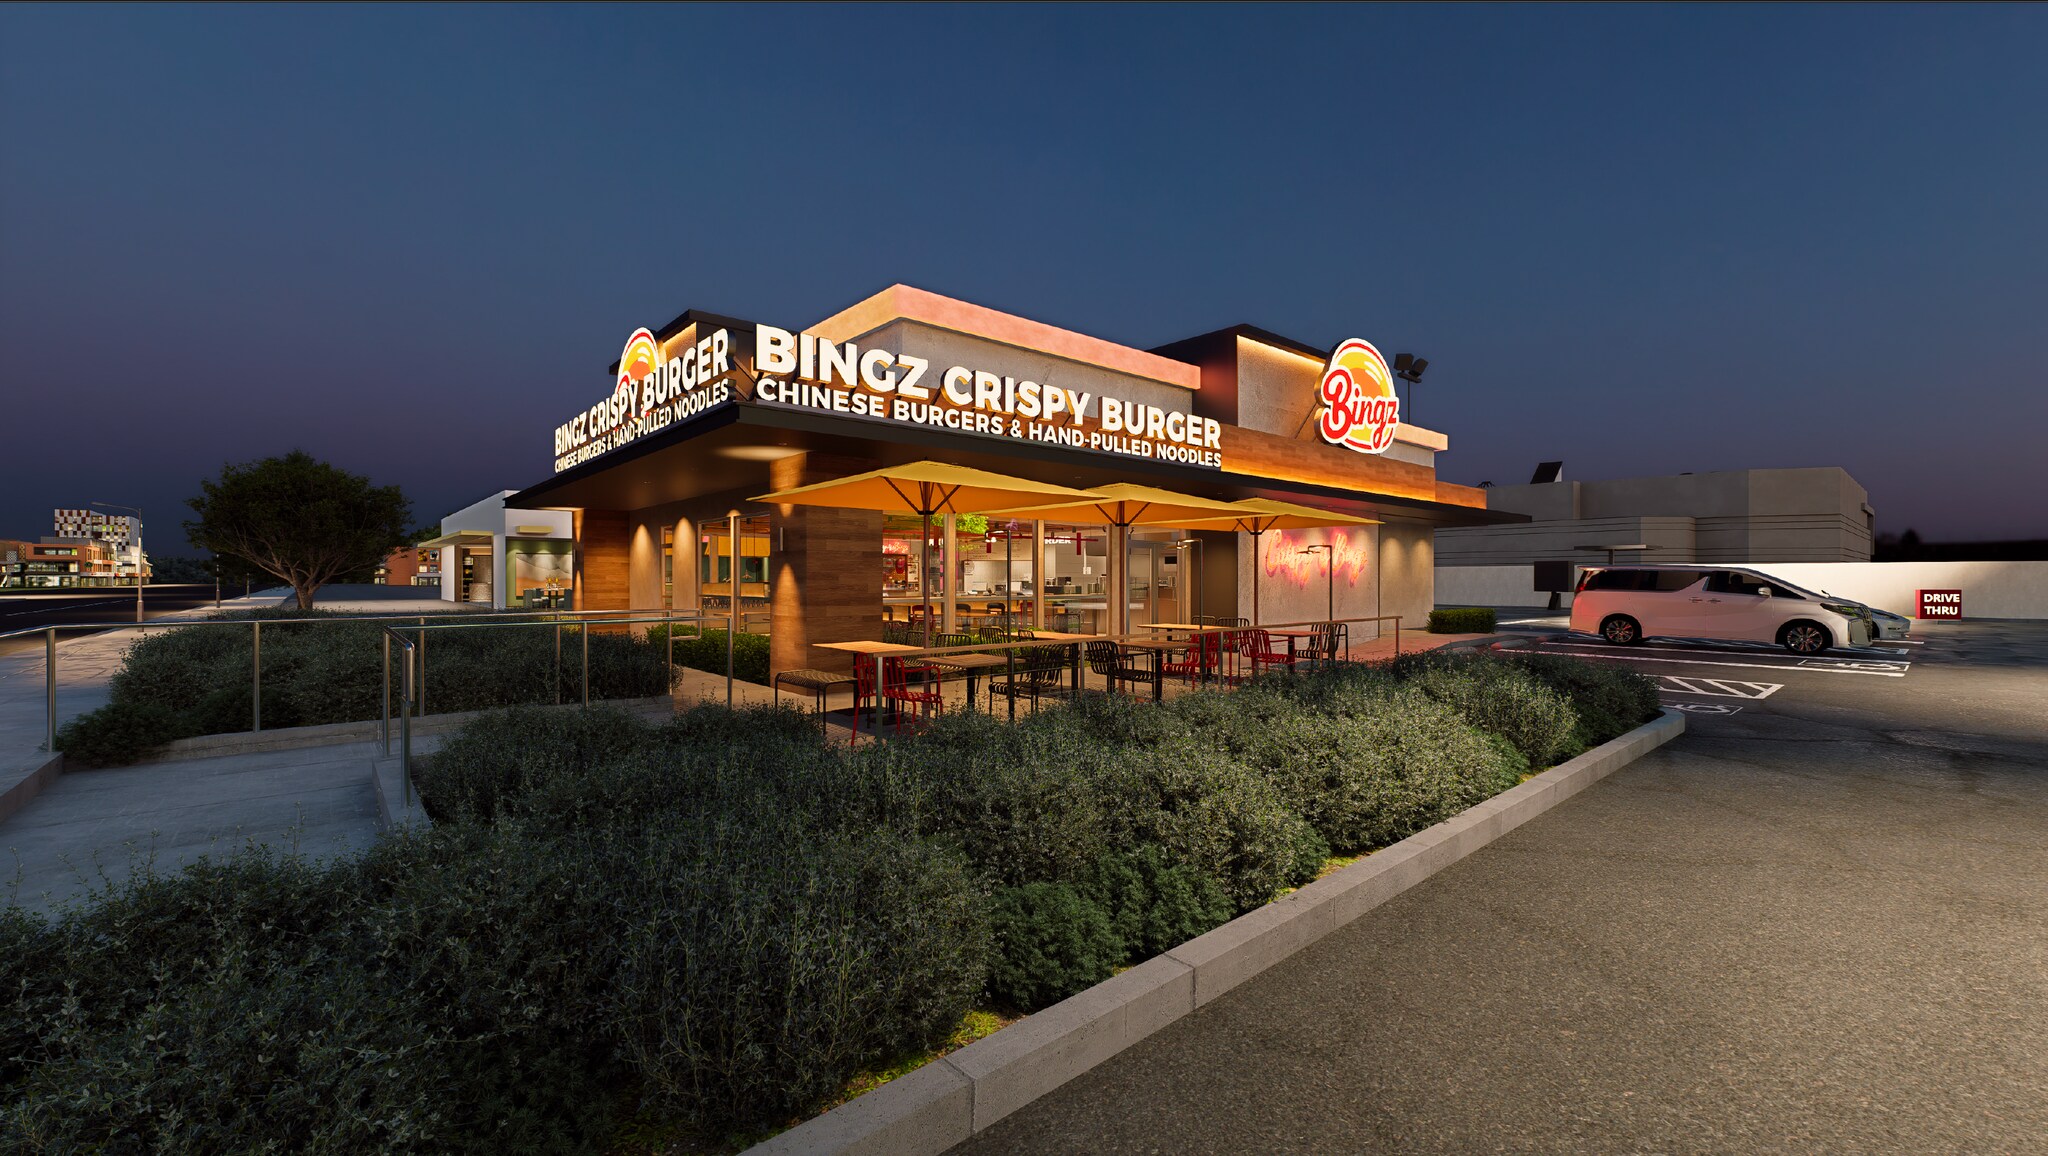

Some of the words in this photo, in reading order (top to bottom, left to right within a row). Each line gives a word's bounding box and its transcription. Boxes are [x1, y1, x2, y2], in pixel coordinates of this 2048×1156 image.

[555, 411, 587, 456] BINGZ
[589, 379, 639, 438] CRISPY
[643, 328, 729, 412] BURGER
[555, 451, 578, 473] CHINESE
[577, 438, 606, 464] BURGERS
[607, 436, 612, 450] &
[613, 406, 671, 447] HAND-PULLED
[674, 378, 729, 422] NOODLES
[756, 323, 929, 399] BINGZ
[943, 365, 1091, 426] CRISPY
[1101, 396, 1221, 450] BURGER
[756, 377, 885, 418] CHINESE
[893, 400, 1003, 435] BURGERS
[1010, 419, 1023, 438] &
[1029, 422, 1151, 457] HAND-PULLED
[1156, 443, 1222, 467] NOODLES
[1322, 368, 1397, 450] Bingz
[1044, 536, 1071, 544] RDER
[1923, 593, 1960, 603] DRIVE
[1923, 605, 1958, 615] THRU
